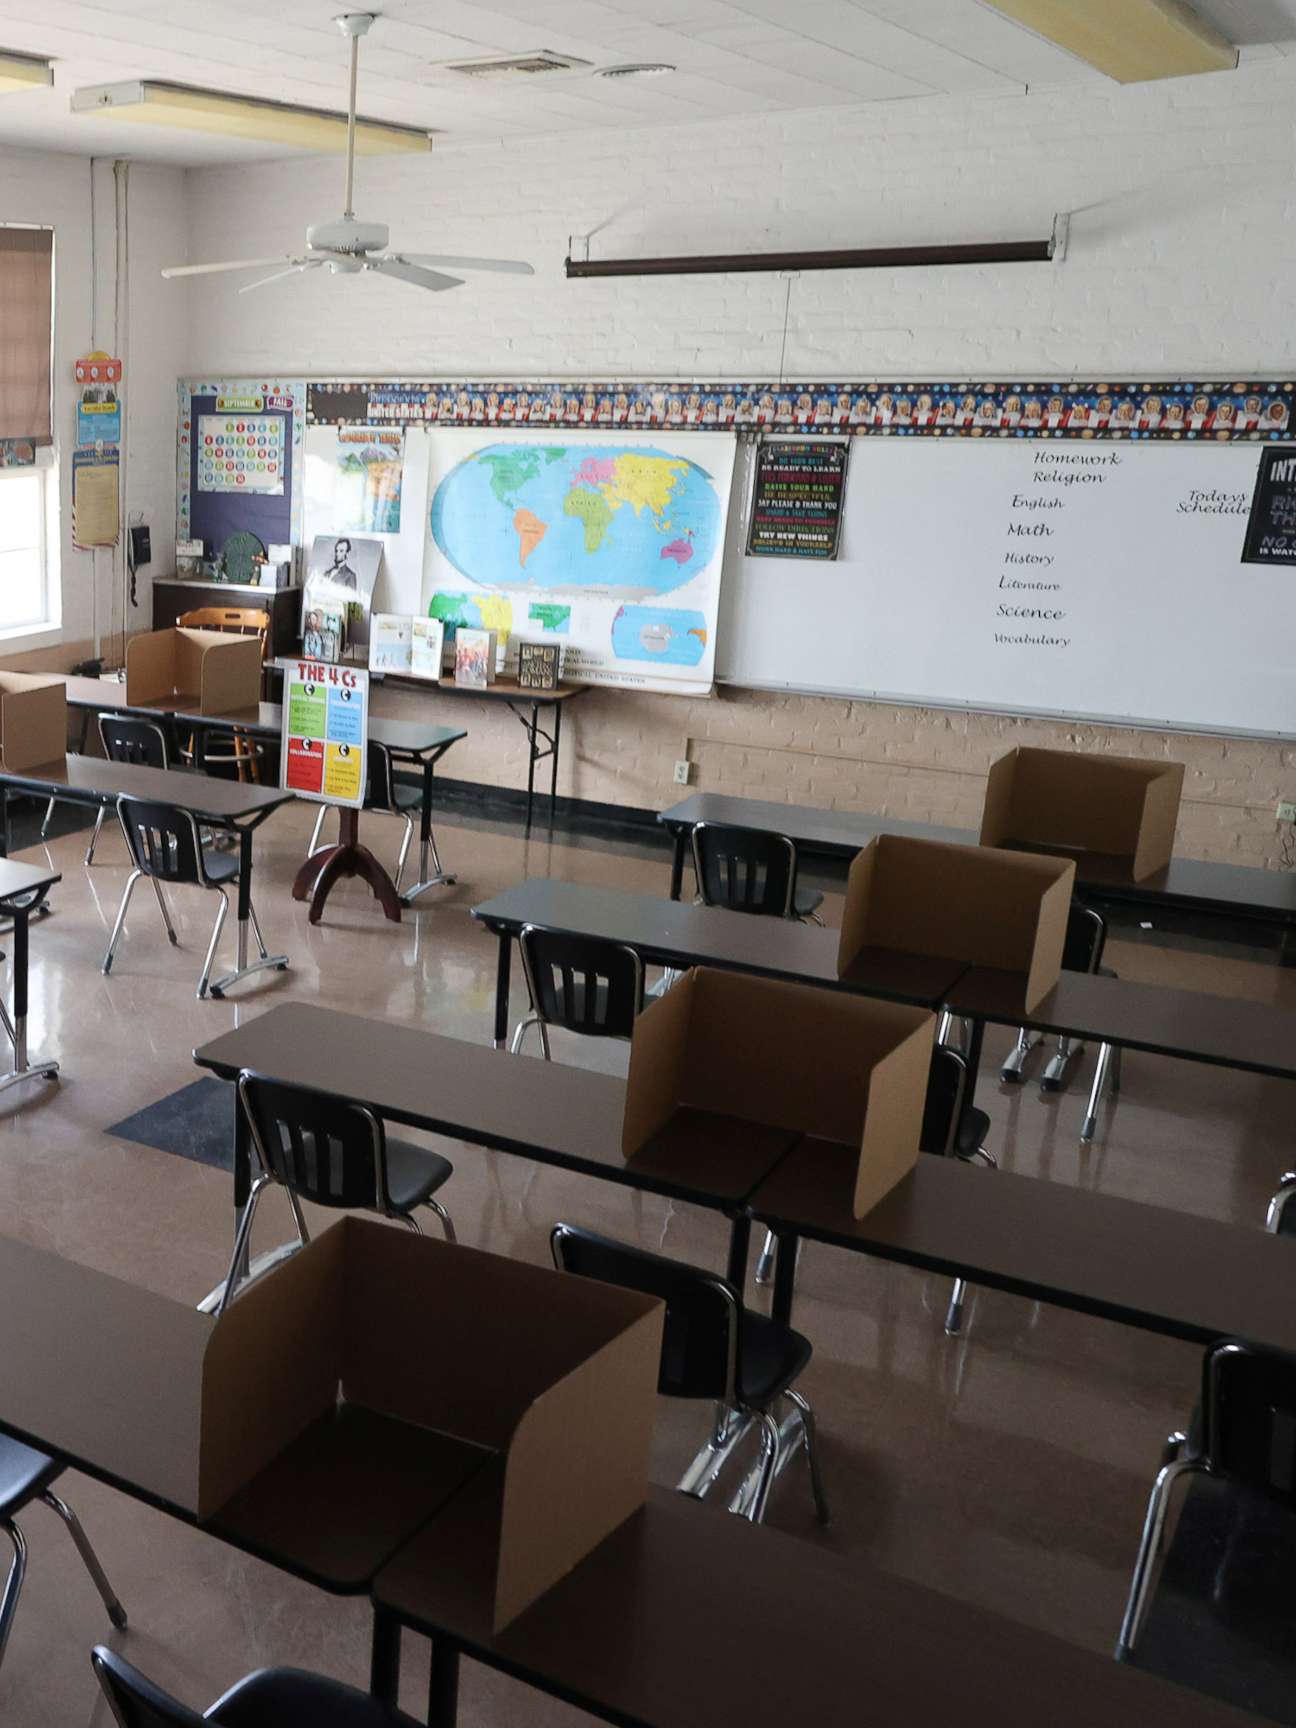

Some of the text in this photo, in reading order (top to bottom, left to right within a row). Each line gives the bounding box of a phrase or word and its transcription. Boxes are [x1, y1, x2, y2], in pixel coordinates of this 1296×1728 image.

[1034, 451, 1122, 465] Homework
[1033, 469, 1106, 487] Religion
[1012, 494, 1066, 511] English
[1189, 489, 1248, 505] Todays
[771, 500, 794, 508] PLEASE
[802, 501, 822, 509] THANK
[824, 501, 837, 510] YOU
[1176, 501, 1251, 514] Schedule
[759, 531, 829, 541] TRY NEW THINGS
[1008, 522, 1054, 536] Math
[1262, 535, 1287, 548] NO
[1260, 547, 1269, 555] IS
[1004, 552, 1054, 567] History
[999, 575, 1061, 590] Literature
[996, 603, 1067, 620] Science
[994, 632, 1071, 648] Vocabulary
[298, 663, 357, 688] THE 4 Cs
